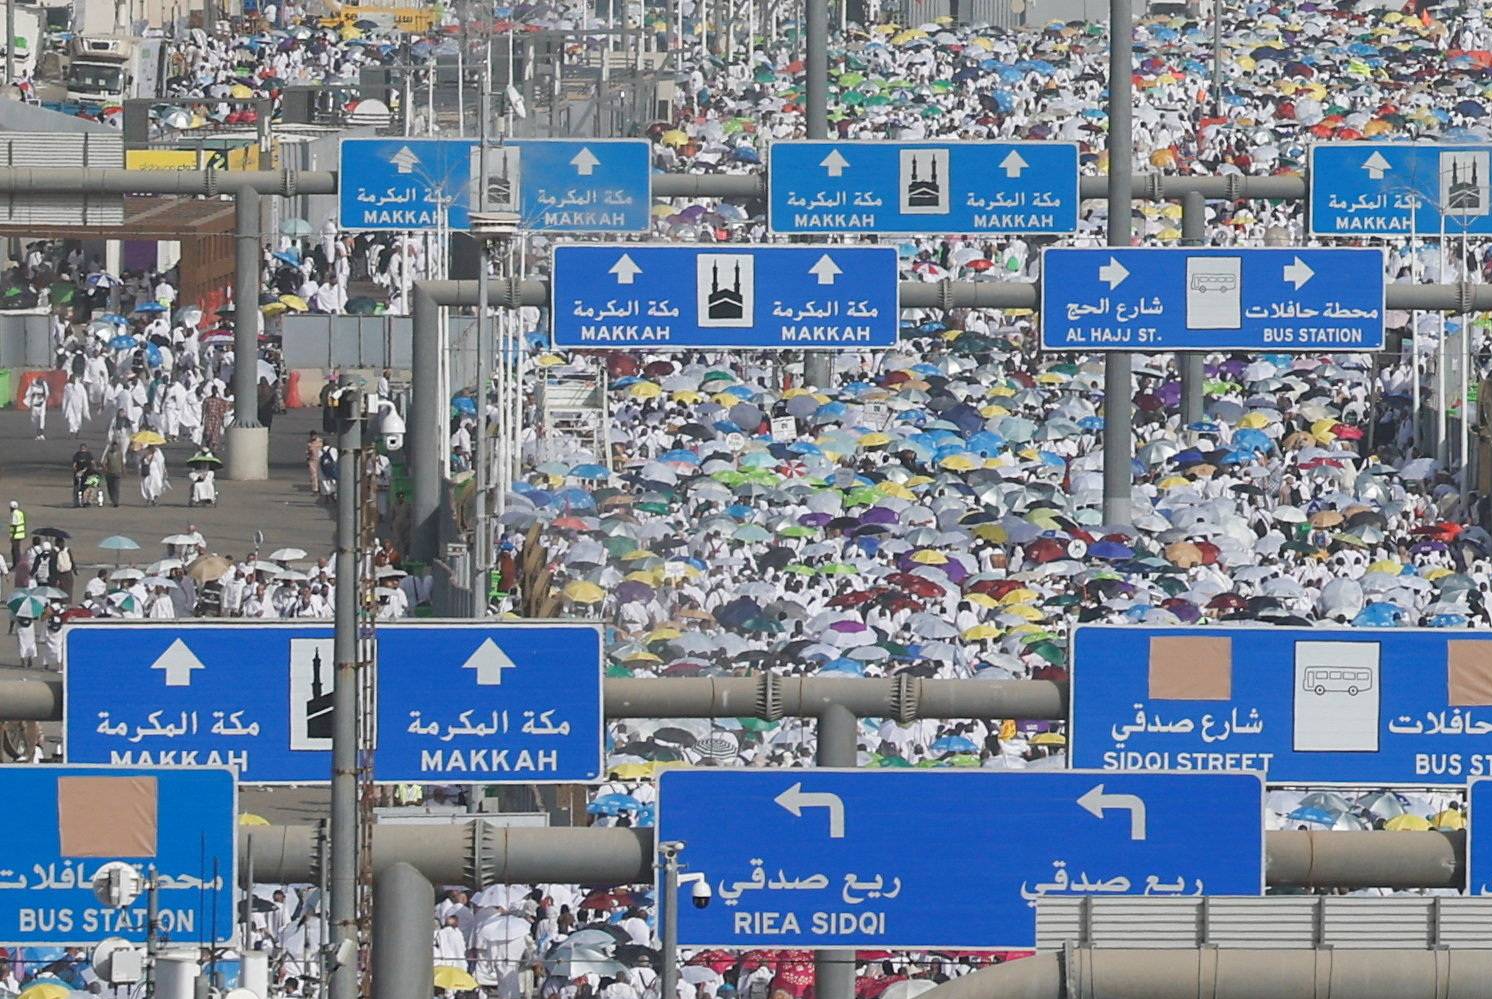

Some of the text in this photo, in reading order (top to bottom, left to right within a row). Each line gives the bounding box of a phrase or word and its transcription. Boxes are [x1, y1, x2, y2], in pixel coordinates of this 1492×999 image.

[356, 187, 417, 206] المكرمة
[787, 191, 883, 210] مكة المكرمة
[966, 191, 1061, 211] مكة المكرمة
[1328, 193, 1387, 213] المكرمة
[545, 213, 625, 226] MAKKAH
[794, 213, 875, 228] MAKKAH
[973, 214, 1054, 228] MAKKAH
[573, 299, 680, 322] مكة المكرمة
[772, 300, 879, 322] مكة المكرمة
[1066, 296, 1164, 323] شارع الحج
[1245, 300, 1379, 319] محطة حافلات
[581, 325, 670, 341] MAKKAH
[781, 325, 870, 342] MAKKAH
[1065, 327, 1162, 343] AL HAJJ ST.
[1263, 327, 1362, 343] BUS STATION
[96, 710, 260, 743] مكة المكرمة
[407, 709, 571, 742] مكة المكرمة
[1111, 703, 1263, 749] شارع صدقي
[110, 750, 248, 771] MAKKAH
[421, 749, 557, 772] MAKKAH
[1177, 753, 1273, 771] STREET
[1415, 753, 1462, 776] BUS
[718, 858, 901, 907] ريع صدقي
[19, 908, 194, 933] BUS STATON
[734, 911, 885, 936] RIEA SIDQI
